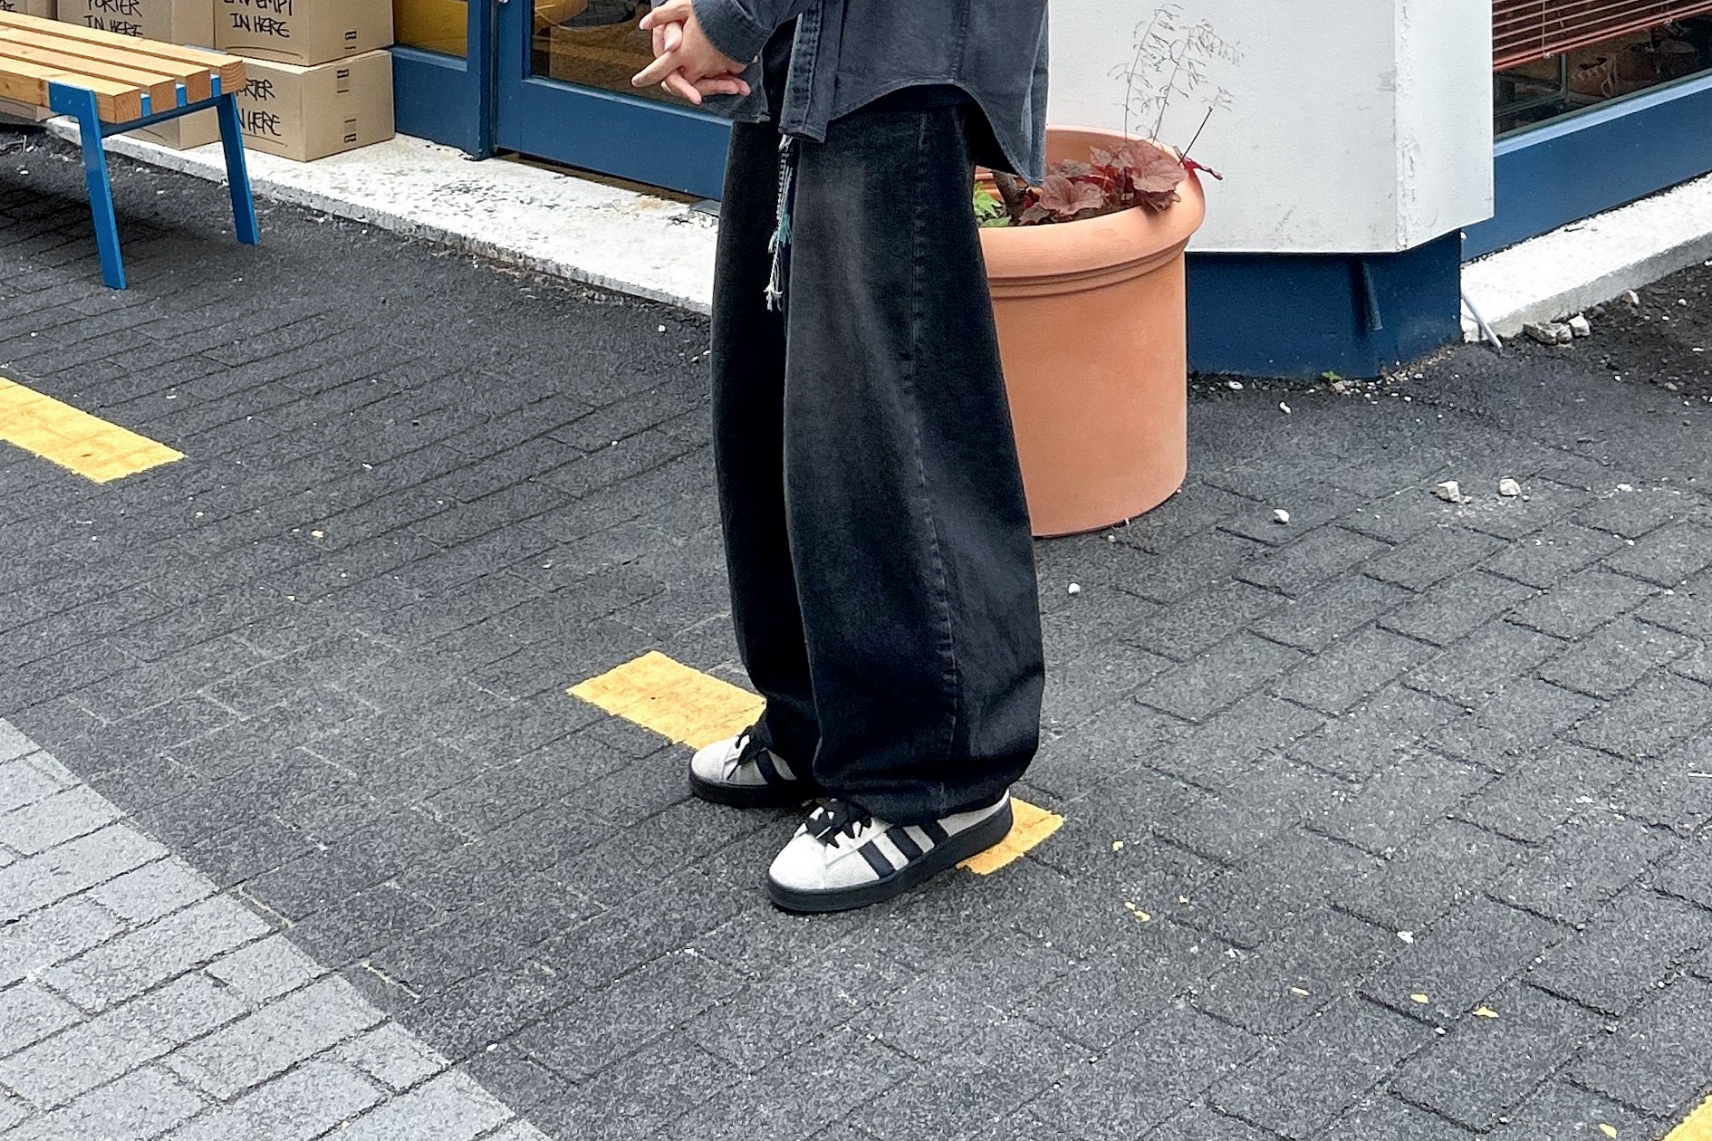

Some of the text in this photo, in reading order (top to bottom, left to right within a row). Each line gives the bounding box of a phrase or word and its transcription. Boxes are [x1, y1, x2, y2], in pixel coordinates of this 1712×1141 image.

[84, 15, 105, 31] IN
[230, 13, 290, 38] IN HERE
[248, 110, 282, 136] HERE
